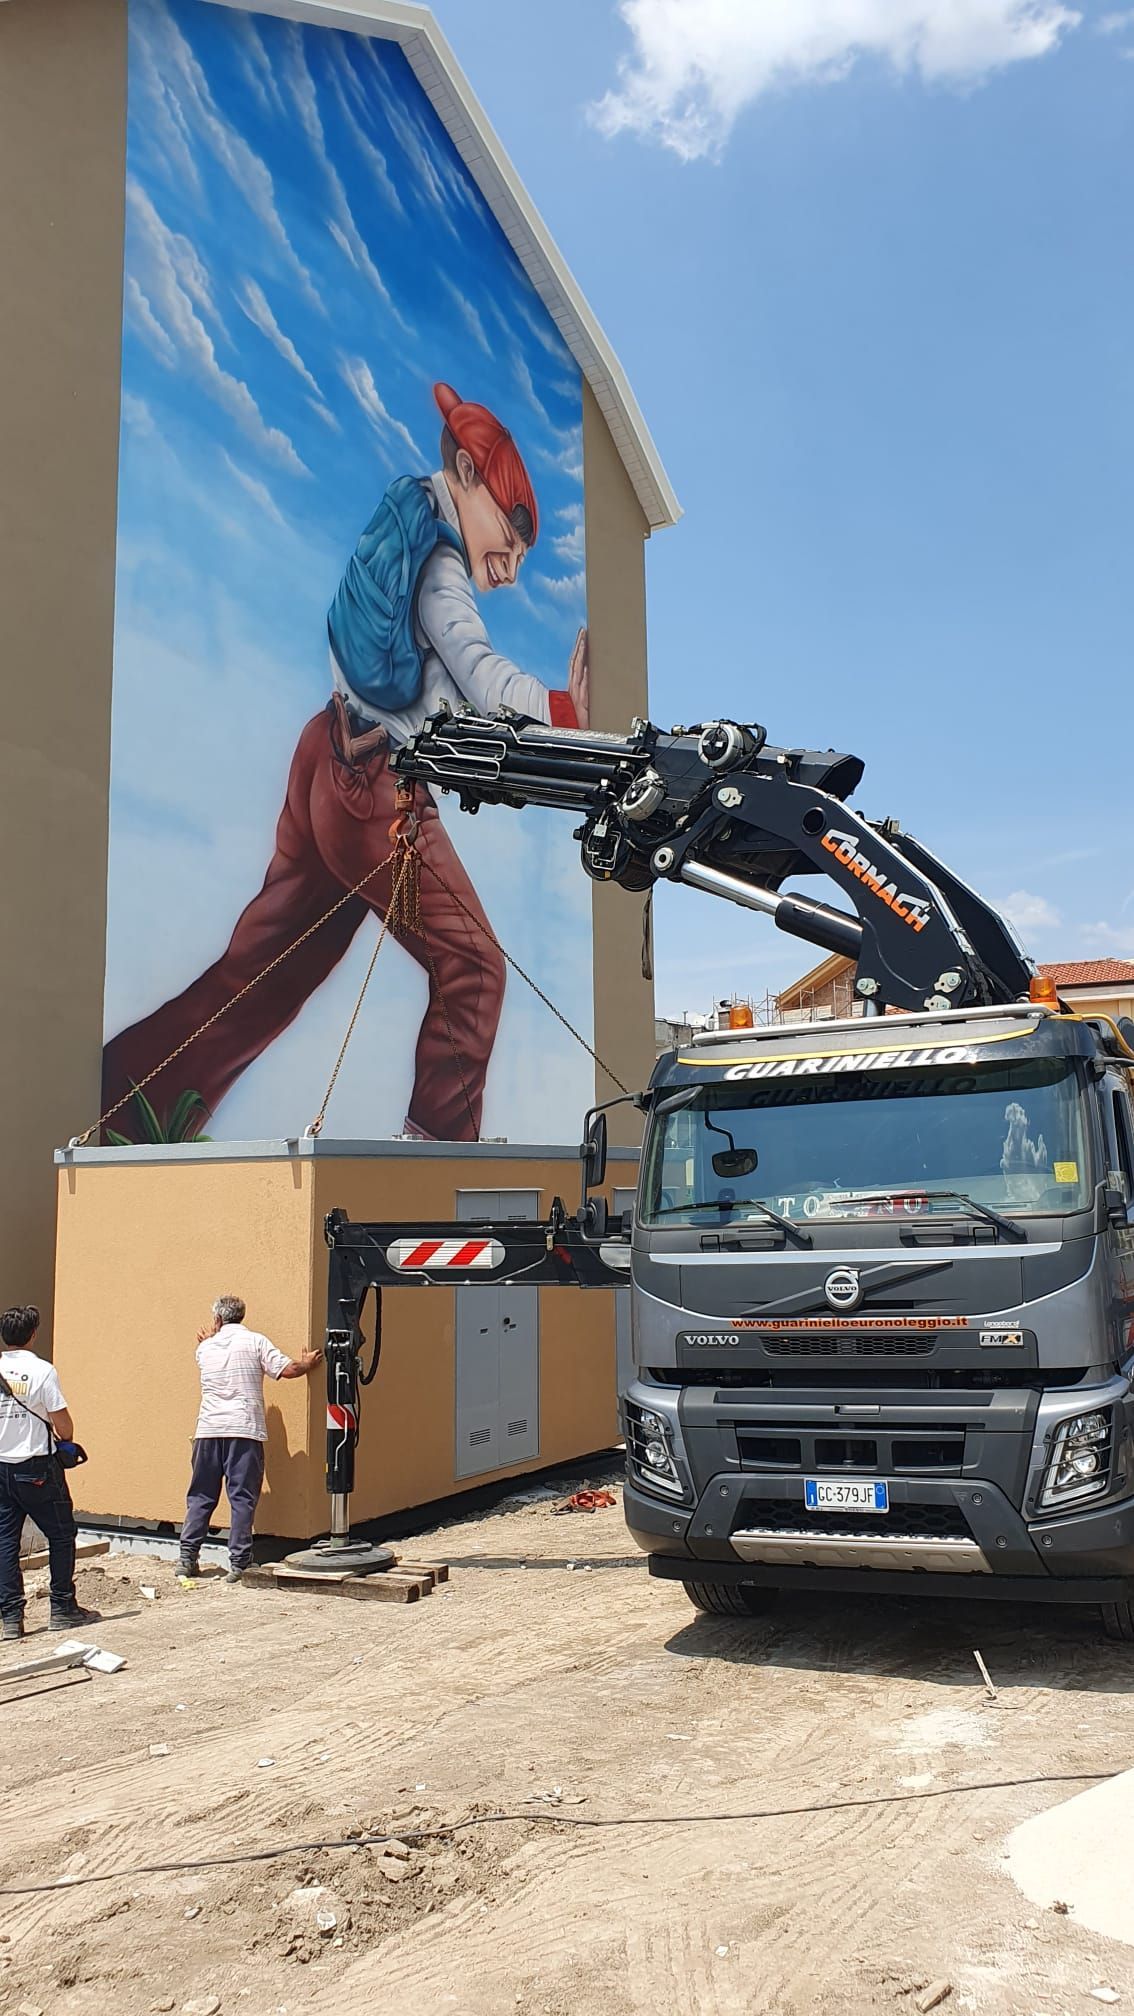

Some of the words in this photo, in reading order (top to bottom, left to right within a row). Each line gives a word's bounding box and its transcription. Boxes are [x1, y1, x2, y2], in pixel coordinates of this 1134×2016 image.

[821, 829, 931, 932] CORMACH
[724, 1047, 968, 1081] GUARINIELLO
[731, 1317, 969, 1331] www.guarinielloeuronoleggio.it
[683, 1335, 739, 1345] VOLVO
[981, 1333, 1021, 1345] FMX
